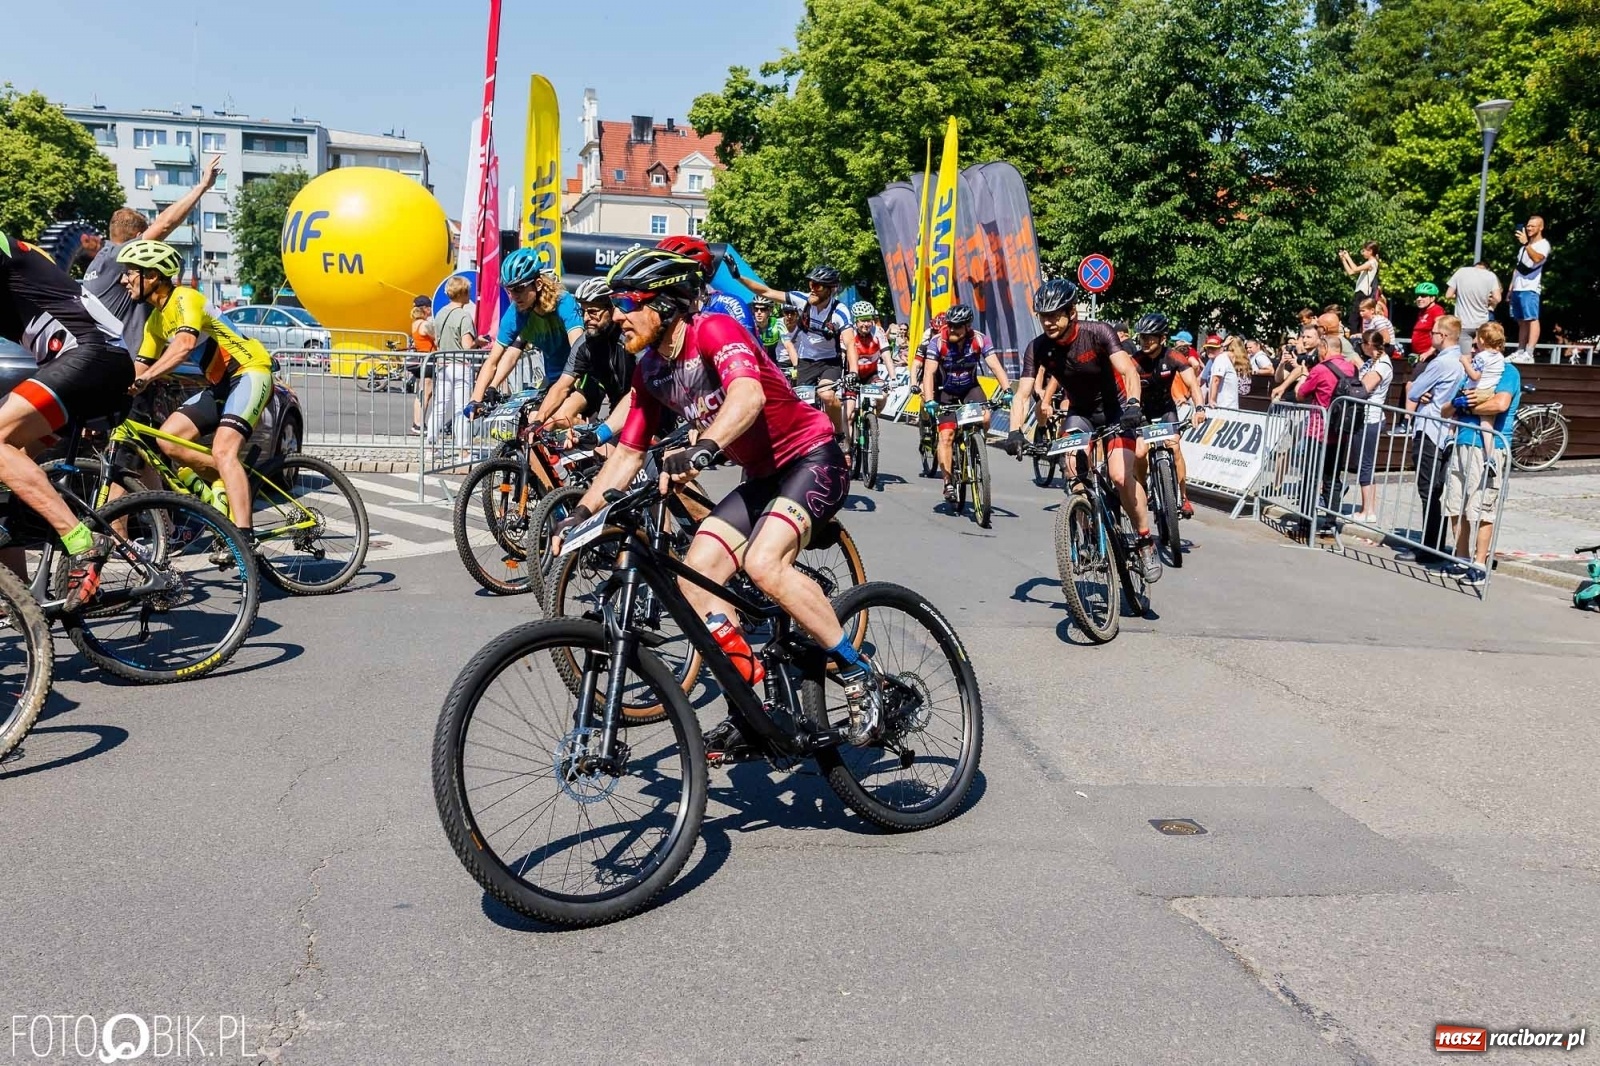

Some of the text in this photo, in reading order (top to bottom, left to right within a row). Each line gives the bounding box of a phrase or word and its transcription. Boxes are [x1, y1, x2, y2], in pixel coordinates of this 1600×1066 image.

[322, 252, 364, 275] FM
[648, 273, 689, 290] SCOTT
[1148, 429, 1169, 438] 1756
[1057, 438, 1083, 449] 1625
